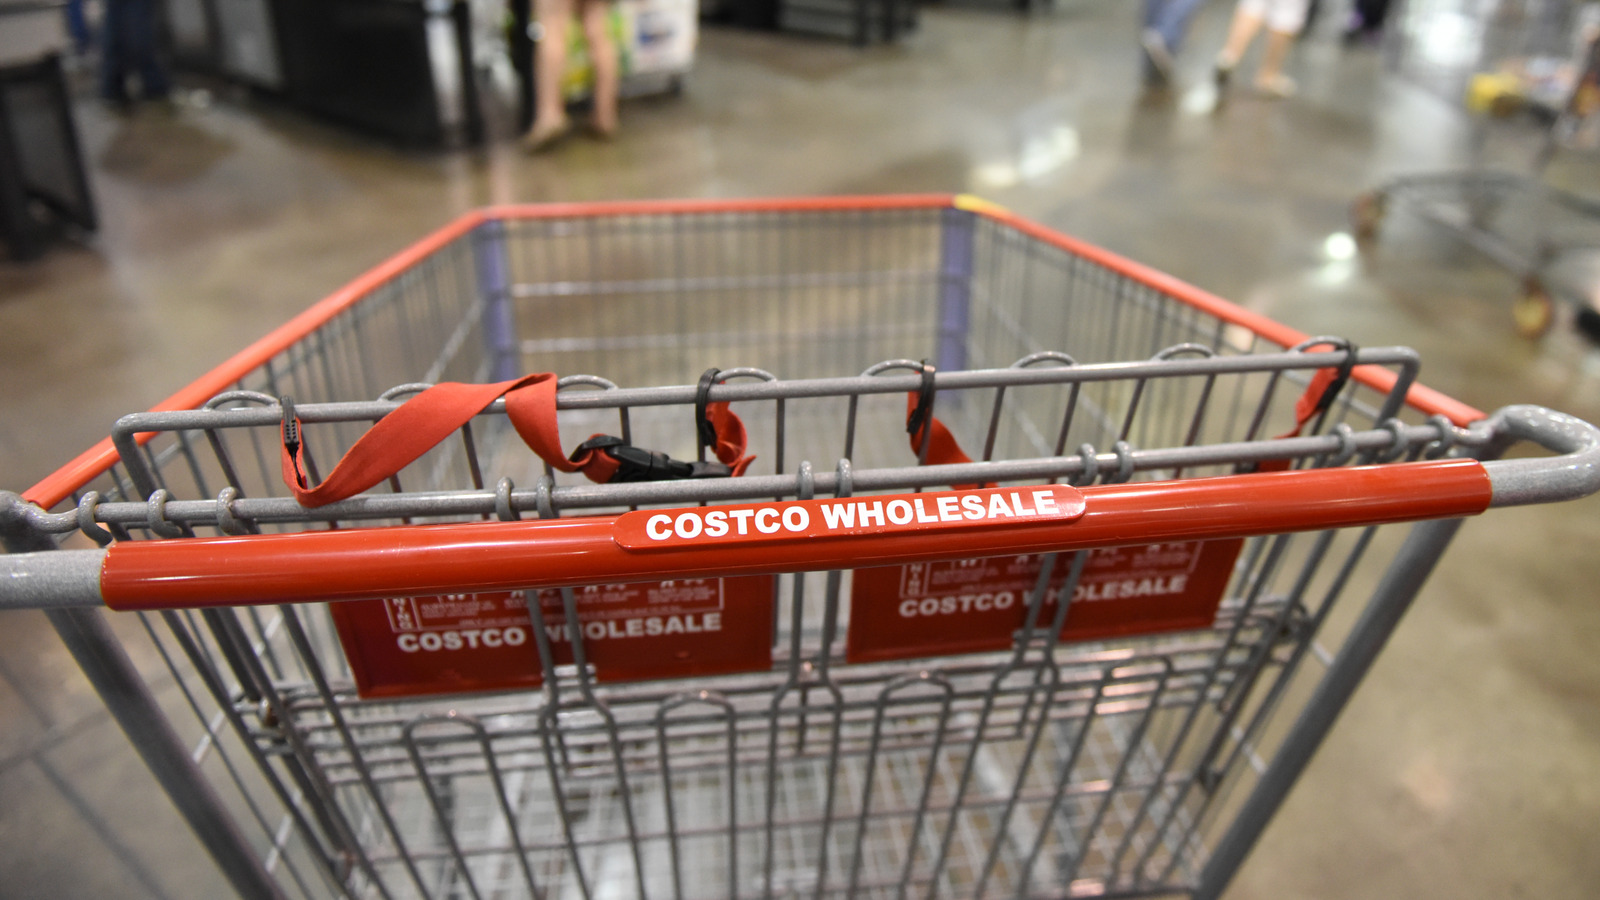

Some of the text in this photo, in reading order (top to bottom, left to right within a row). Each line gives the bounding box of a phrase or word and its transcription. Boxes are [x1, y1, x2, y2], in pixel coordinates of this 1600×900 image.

[646, 490, 1060, 541] COSTCO WHOLESALE
[899, 592, 1015, 618] COSTCO
[397, 627, 526, 653] COSTCO
